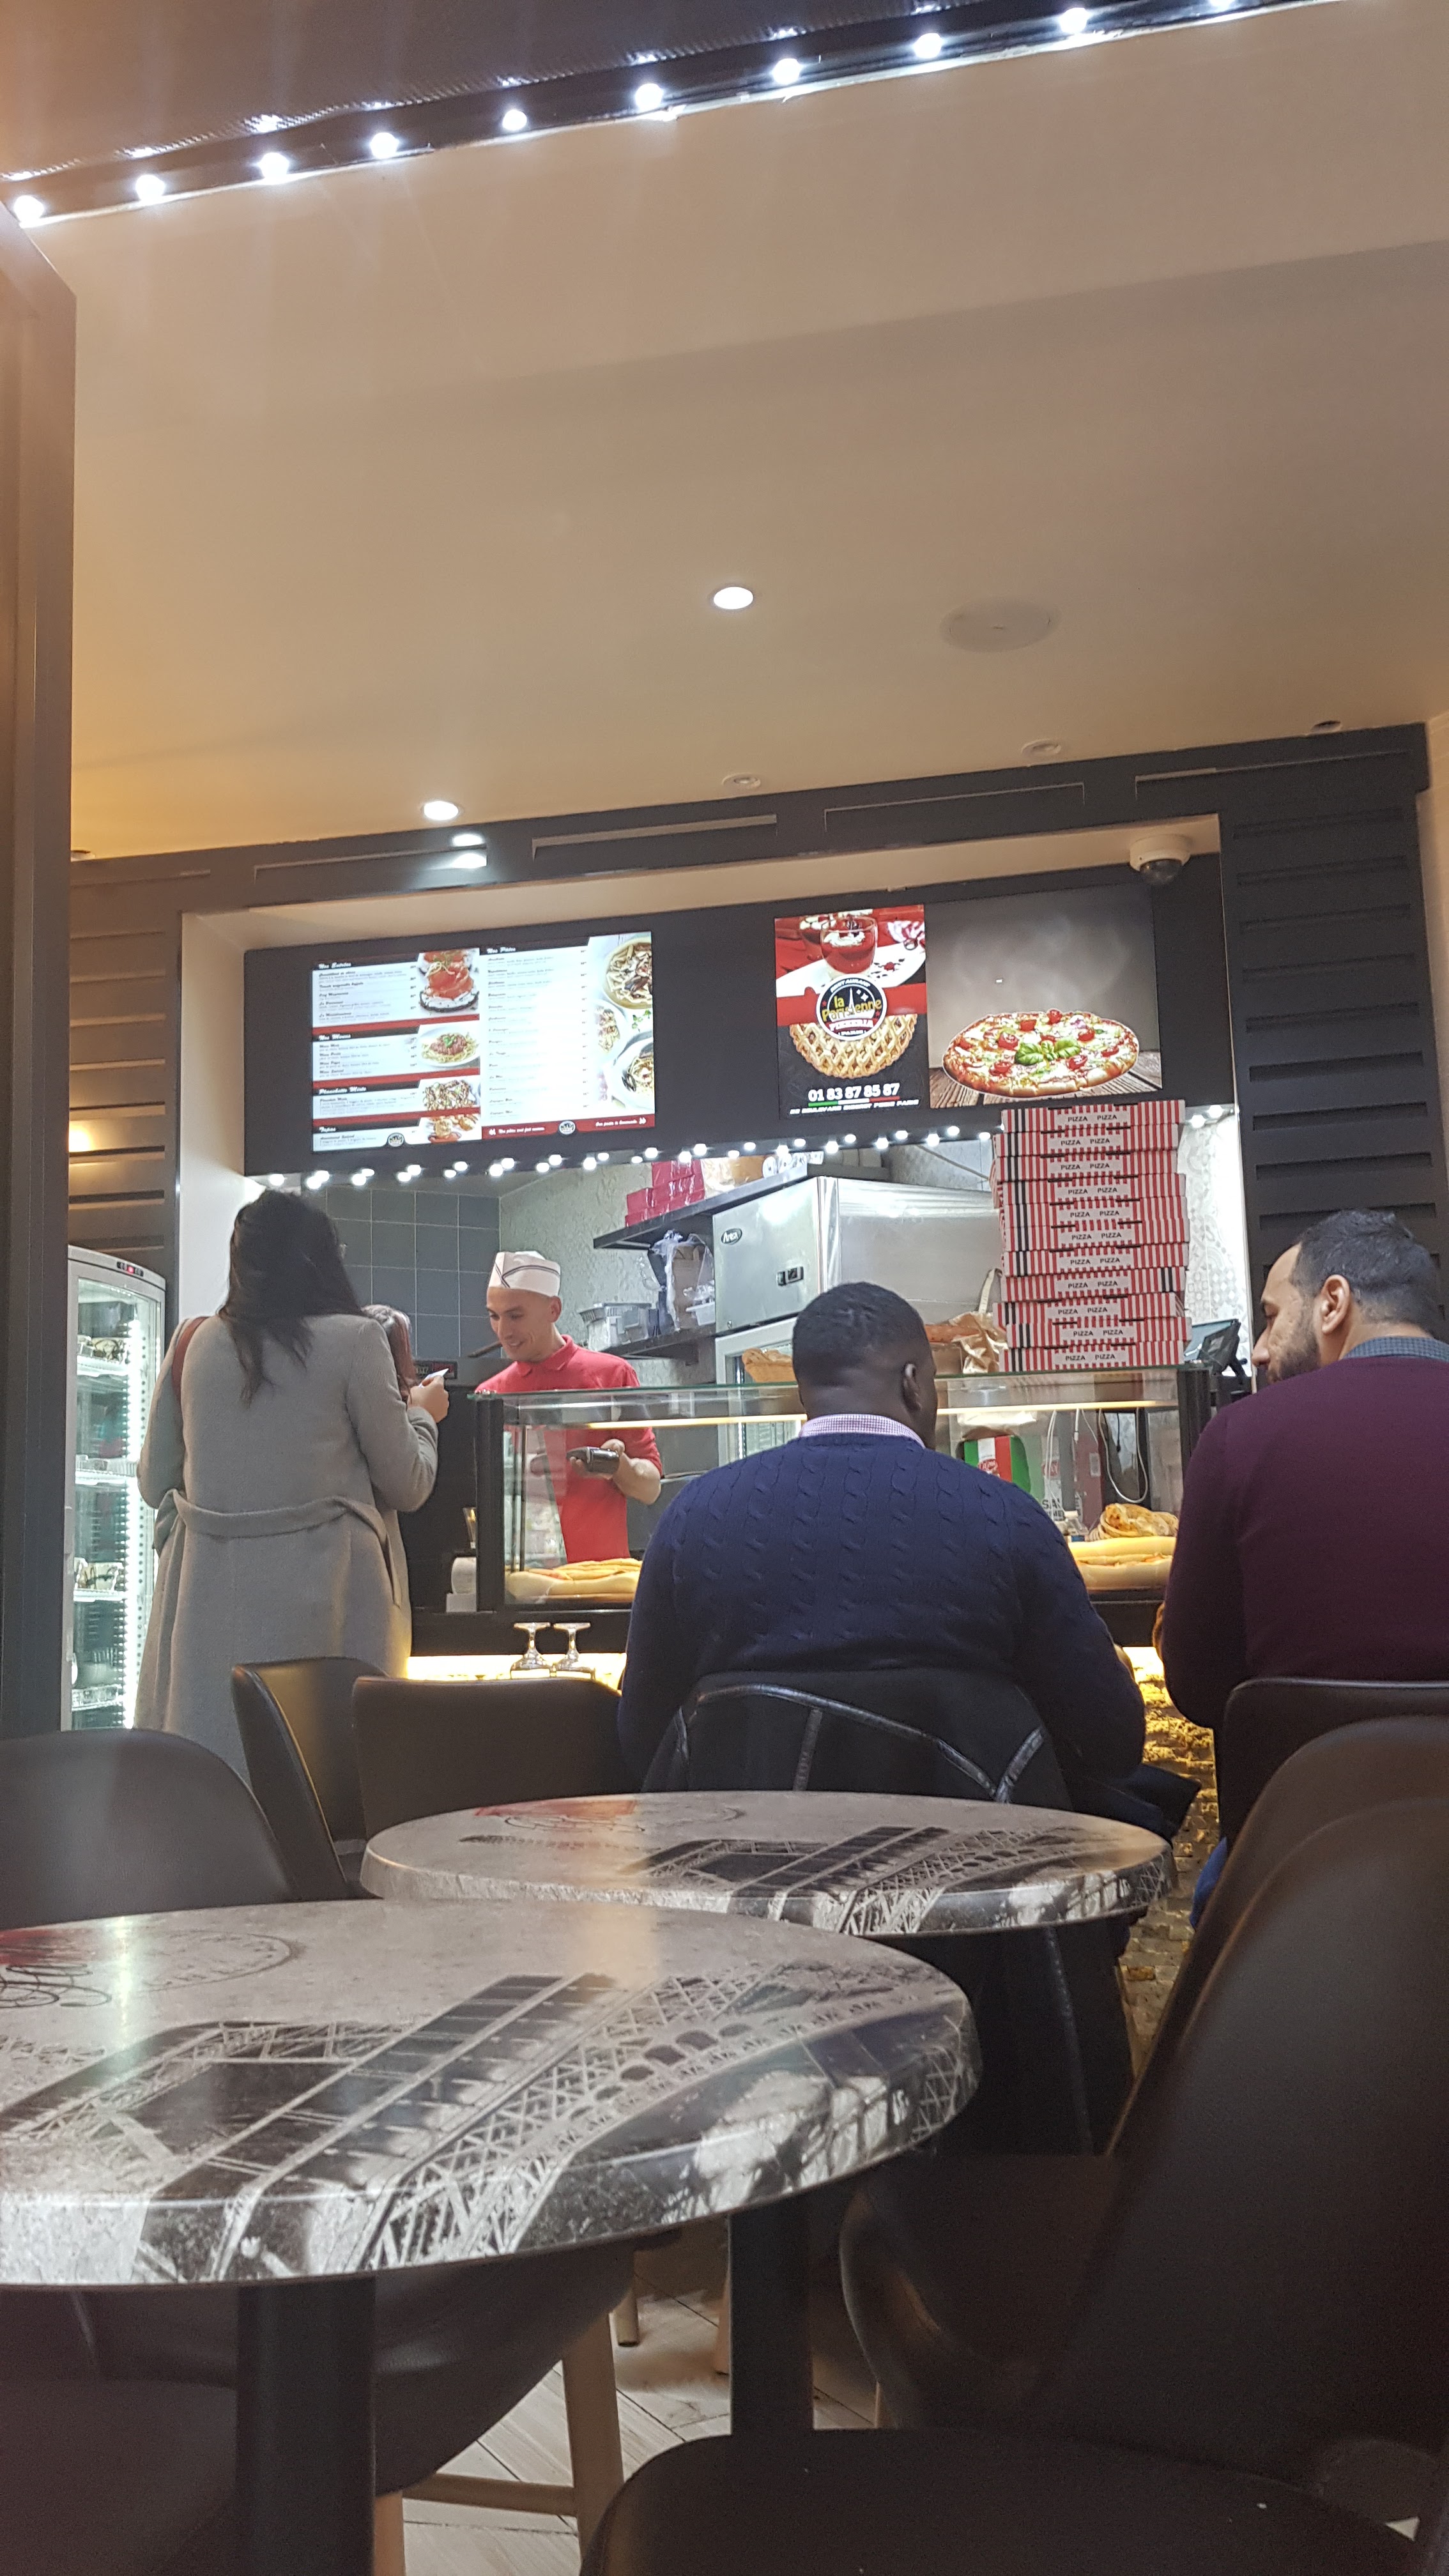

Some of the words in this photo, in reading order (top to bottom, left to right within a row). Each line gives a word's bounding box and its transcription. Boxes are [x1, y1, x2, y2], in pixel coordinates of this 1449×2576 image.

[822, 999, 882, 1022] Parisienne
[834, 995, 845, 1008] la
[808, 1089, 824, 1101] 01
[826, 1087, 843, 1100] 83
[845, 1086, 862, 1099] 87
[864, 1084, 880, 1098] 85
[883, 1083, 900, 1096] 87
